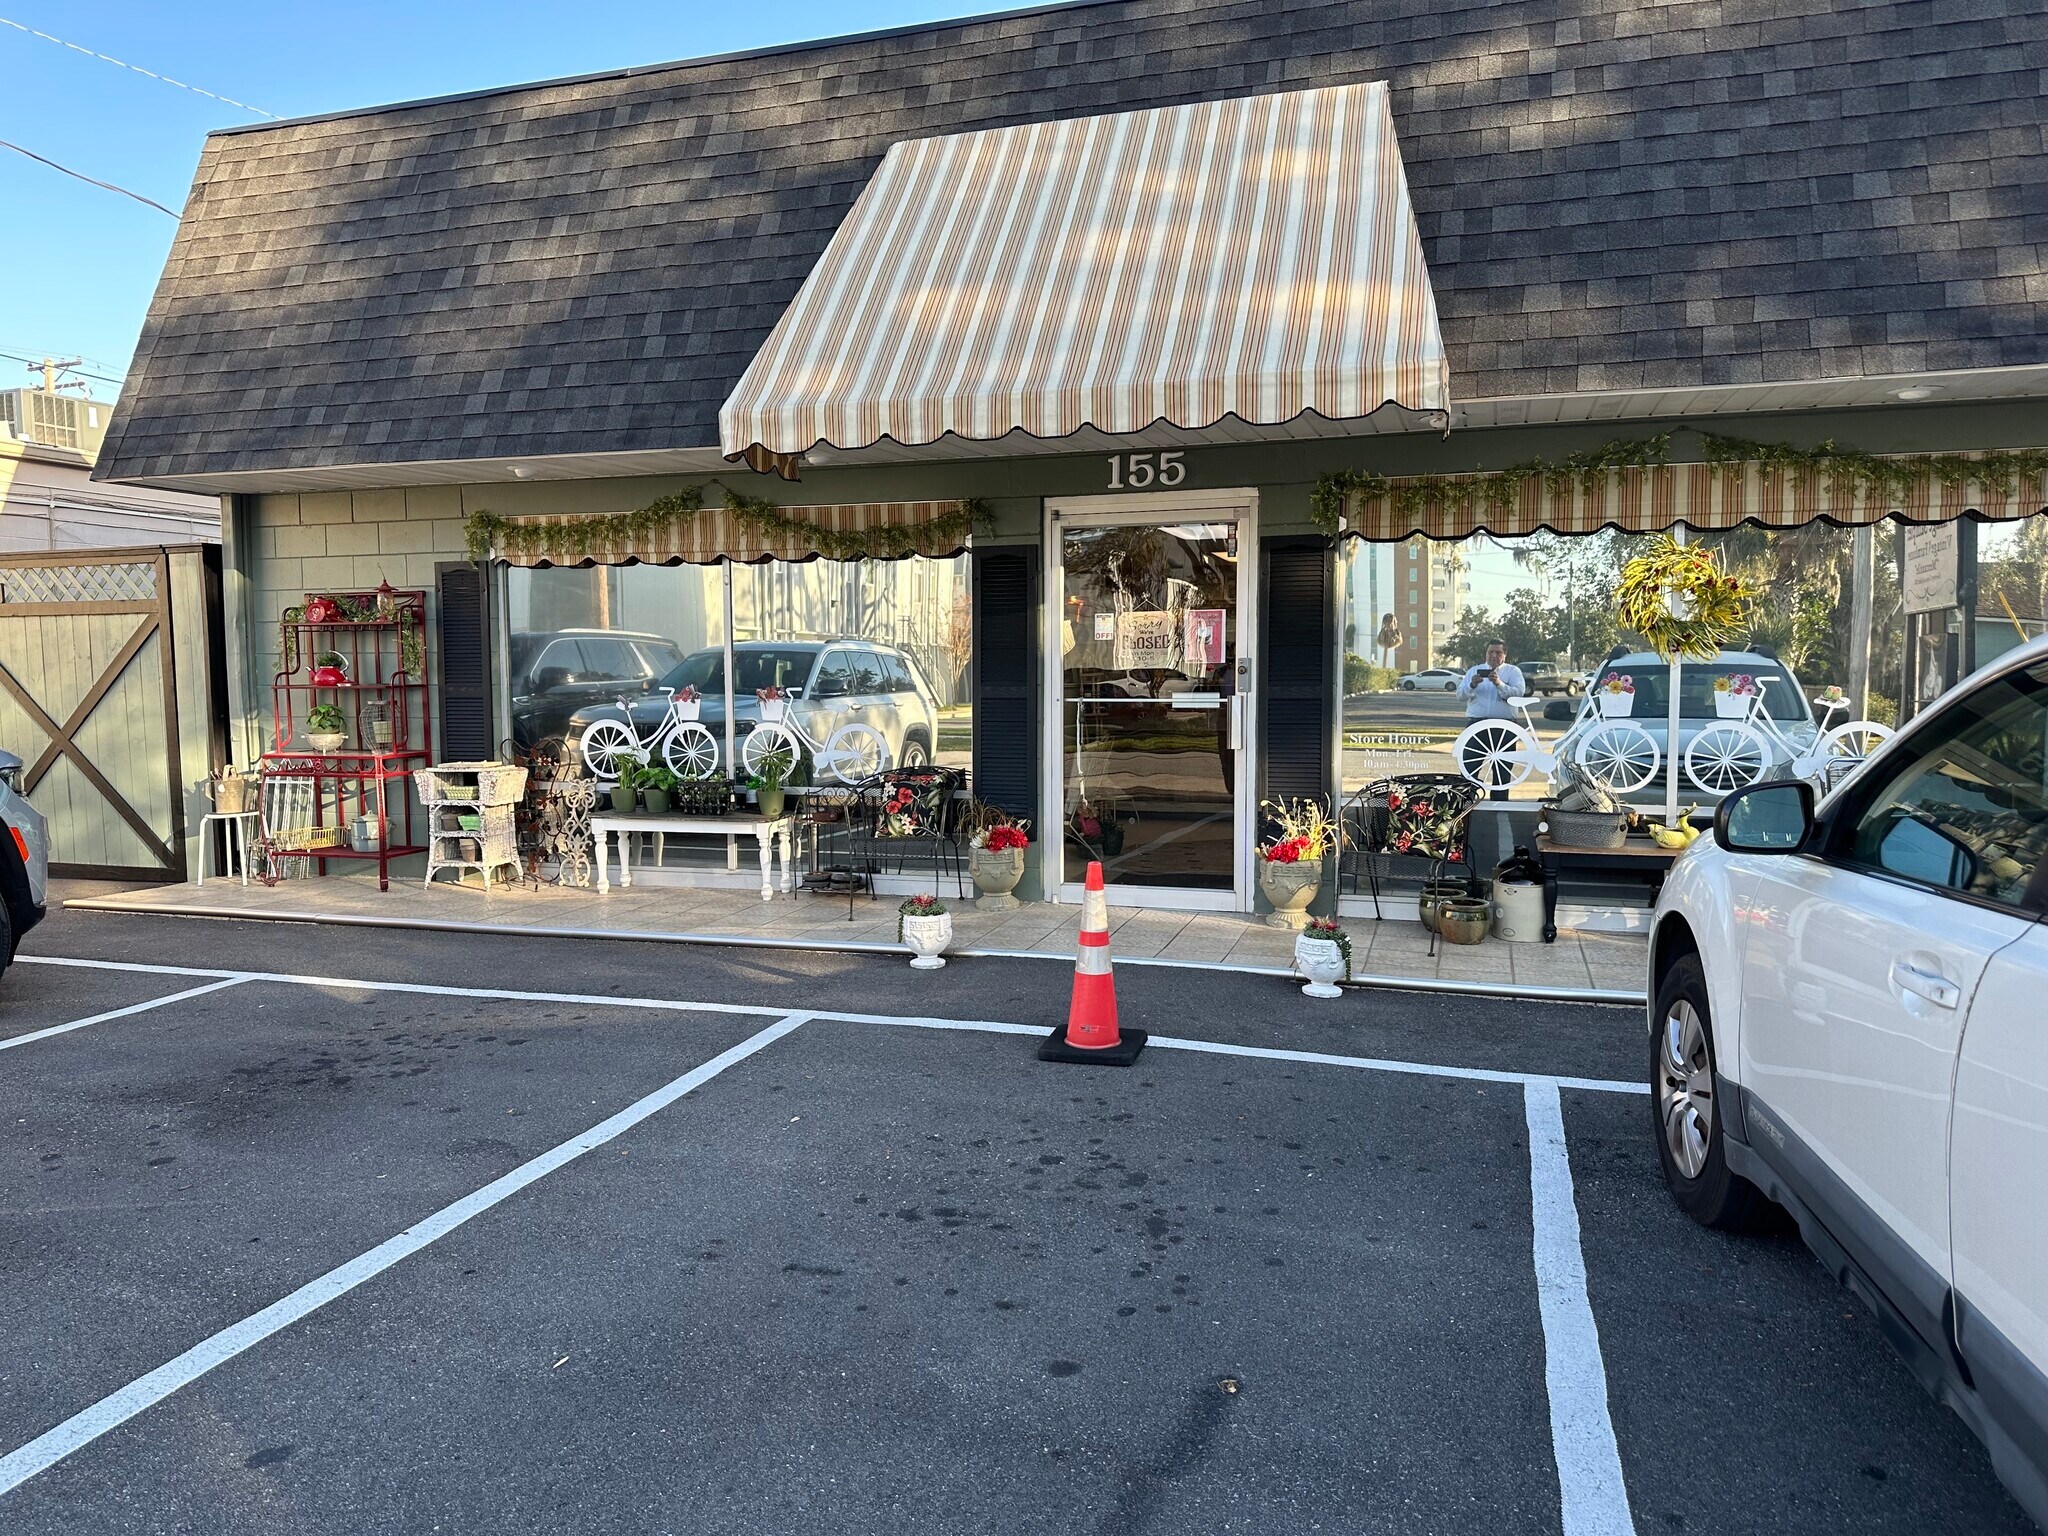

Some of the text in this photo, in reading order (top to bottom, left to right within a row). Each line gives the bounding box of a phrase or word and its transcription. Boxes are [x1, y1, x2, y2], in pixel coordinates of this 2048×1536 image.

[1107, 451, 1187, 489] 155
[1128, 620, 1163, 631] Sorry
[1095, 632, 1113, 640] OFF!
[1349, 733, 1431, 745] Store Hours
